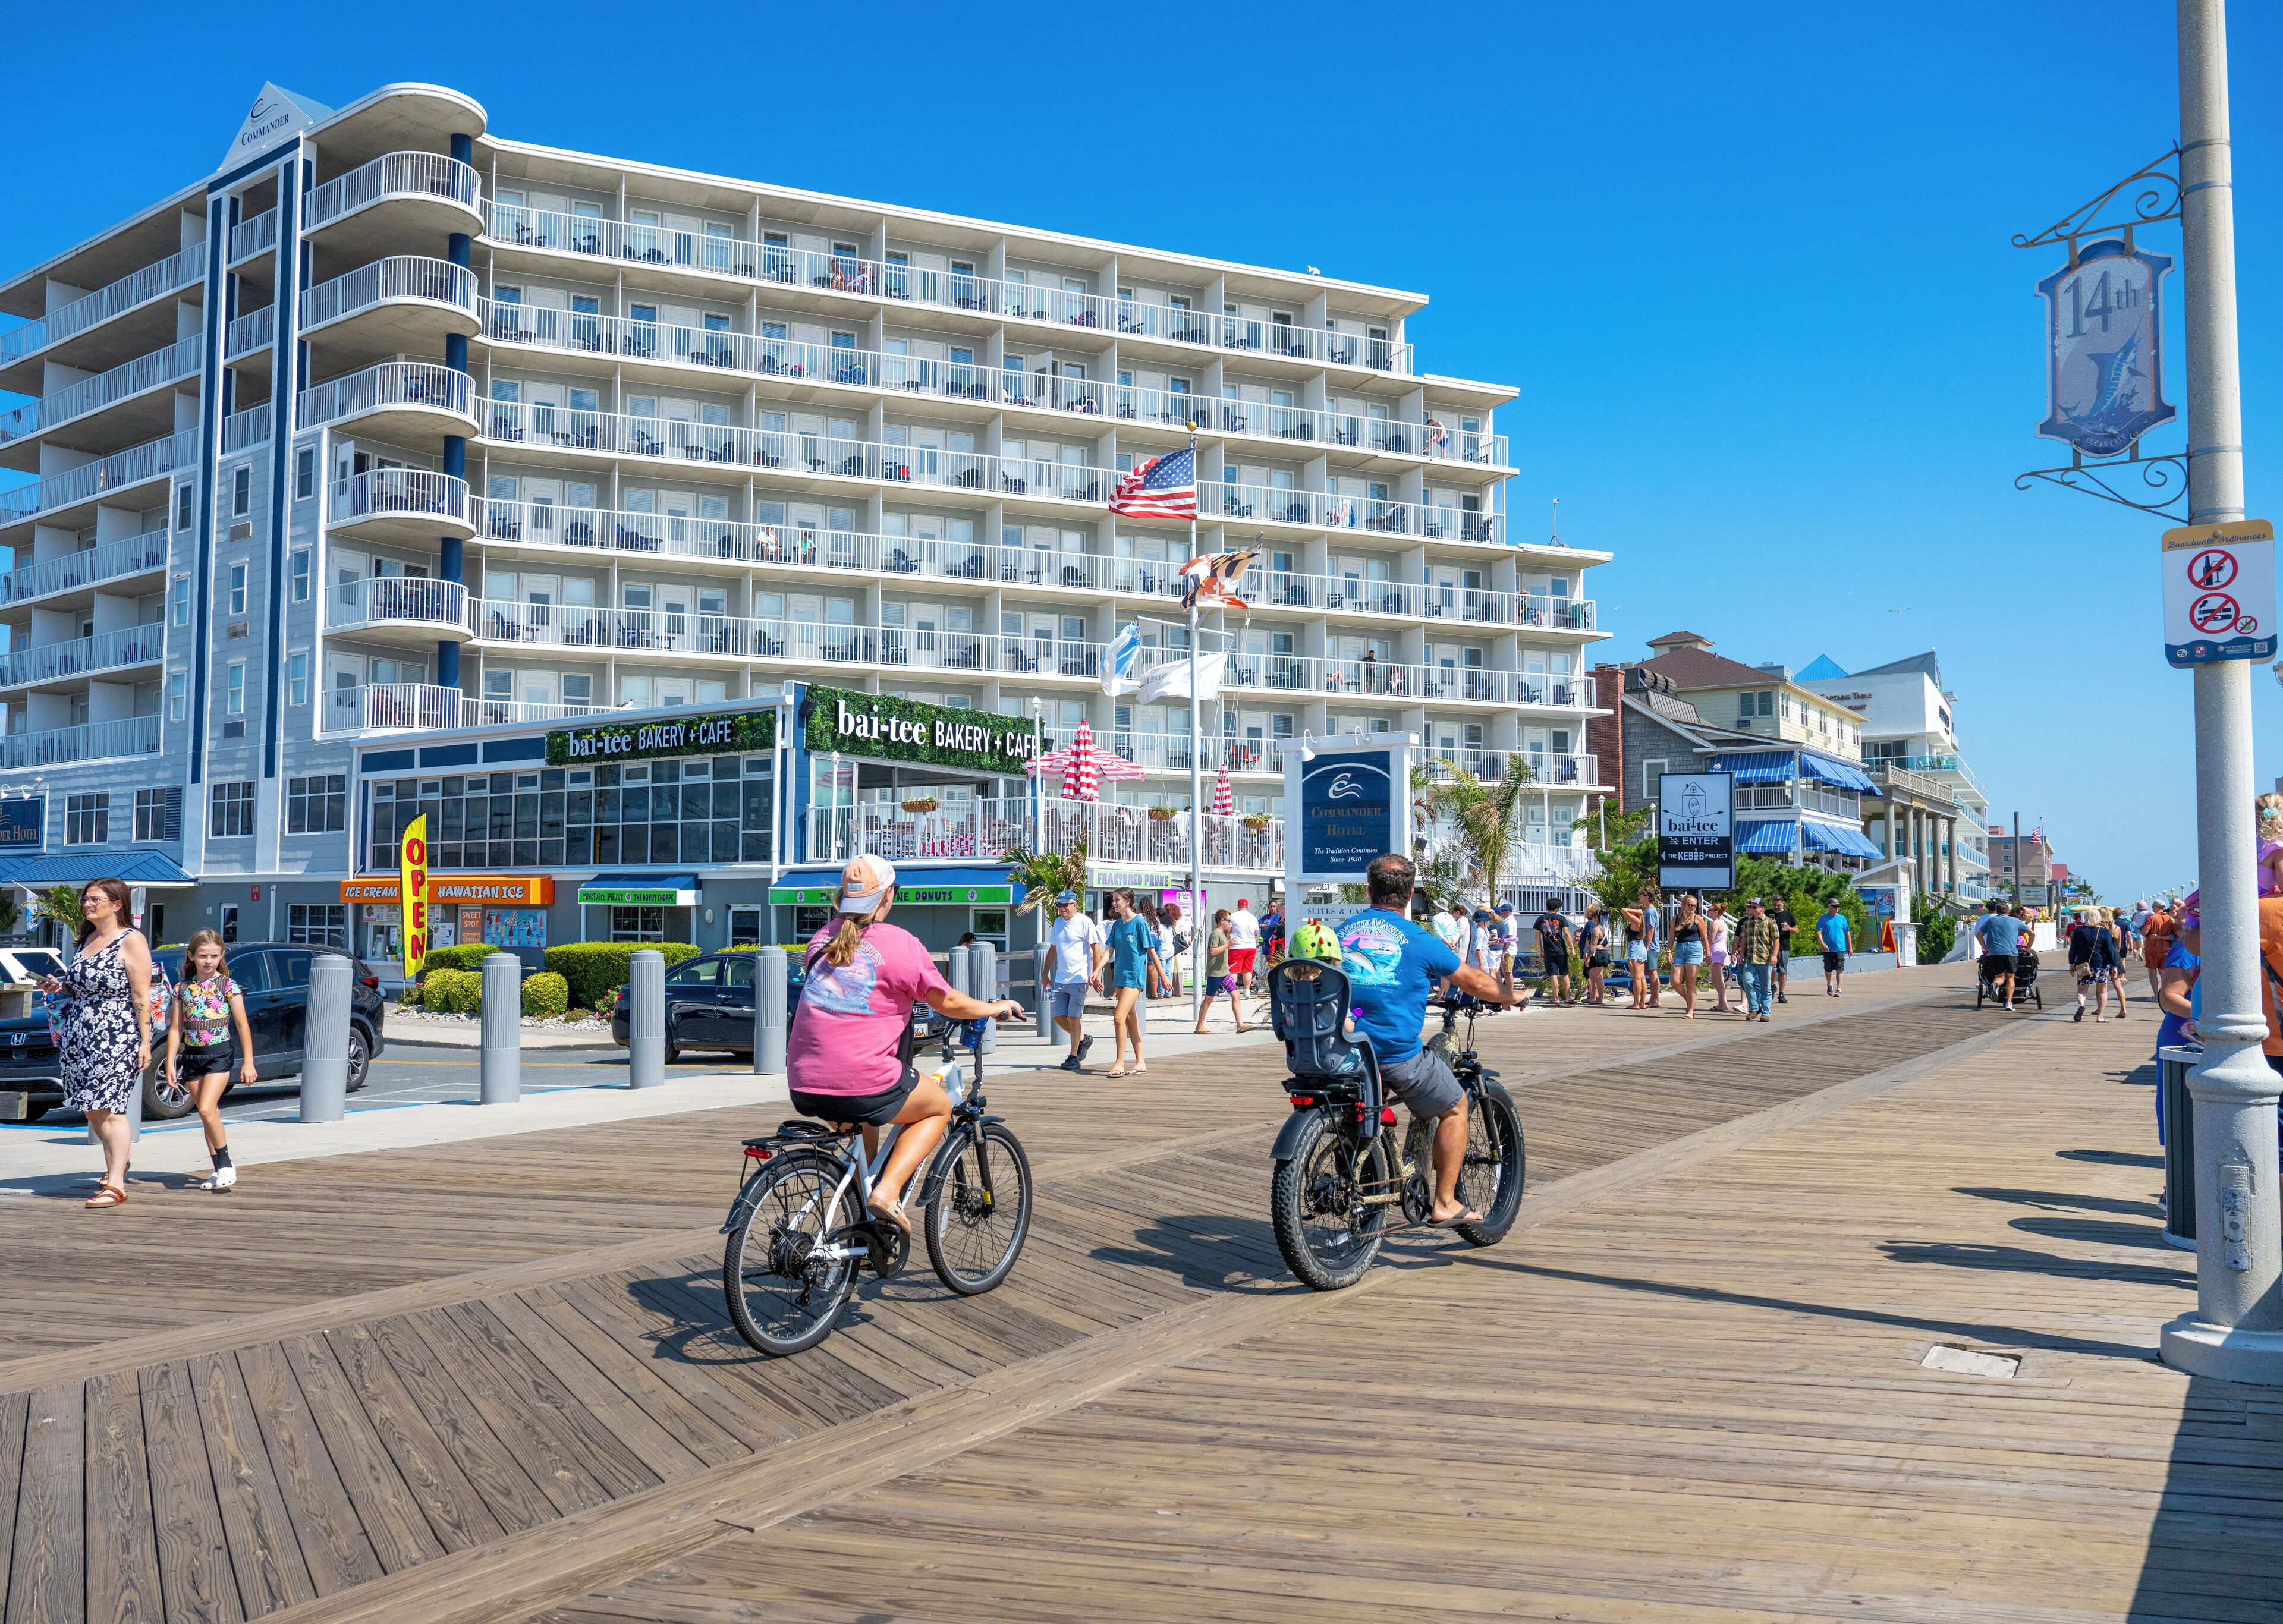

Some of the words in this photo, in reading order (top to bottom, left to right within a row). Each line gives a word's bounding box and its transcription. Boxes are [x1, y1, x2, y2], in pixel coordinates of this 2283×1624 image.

[242, 114, 289, 146] COMMANDER
[2063, 269, 2141, 339] 14th
[2086, 437, 2108, 448] OCEAN
[2109, 435, 2127, 446] CITY
[2168, 537, 2216, 549] Boardwalk
[2218, 533, 2266, 543] Ordinances
[837, 700, 926, 745] bai-tee
[935, 720, 991, 753] BAKERY
[568, 729, 632, 757] bai-tee
[638, 725, 685, 750] BAKERY
[699, 720, 731, 745] CAFE
[1311, 807, 1381, 818] COMMANDER
[1327, 824, 1366, 836] HOTEL
[1668, 818, 1718, 832] bai-tee
[13, 825, 38, 841] HOTEL
[1683, 836, 1719, 845] ENTER
[1098, 872, 1143, 886] FRACTURED
[1144, 874, 1169, 887] PRUNE
[345, 886, 360, 898] ICE
[363, 886, 398, 898] CREAM
[406, 838, 426, 960] OPEN
[437, 885, 500, 898] HAWAIIAN
[502, 885, 524, 899] ICE
[607, 893, 624, 902] PRUNE
[634, 893, 642, 902] THE
[643, 893, 657, 902] DONUT
[658, 893, 674, 902] SHOPPE
[915, 890, 953, 902] DONUTS
[1337, 919, 1370, 938] WHITE
[1369, 918, 1409, 945] MARLIN
[1357, 928, 1383, 937] OPEN
